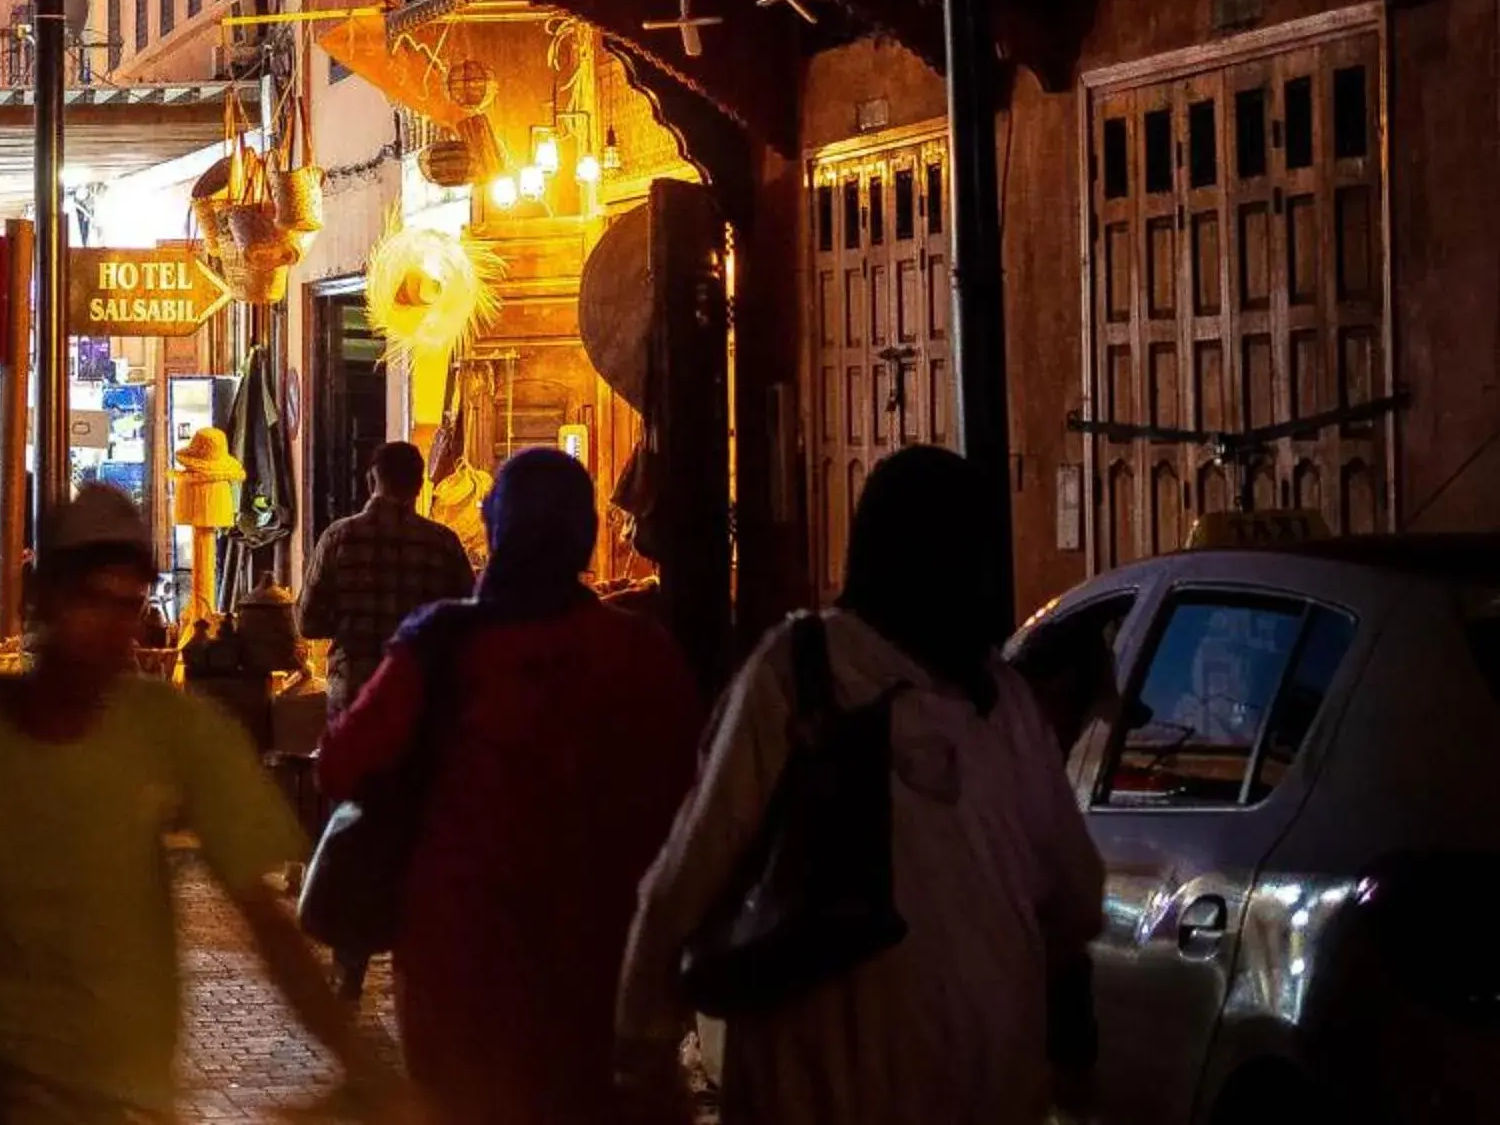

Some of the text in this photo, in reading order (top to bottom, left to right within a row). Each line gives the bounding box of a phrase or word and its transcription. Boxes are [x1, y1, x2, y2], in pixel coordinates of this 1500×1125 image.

[98, 262, 193, 290] HOTEL
[90, 298, 199, 322] SALSABIL
[1229, 516, 1310, 542] TAXI
